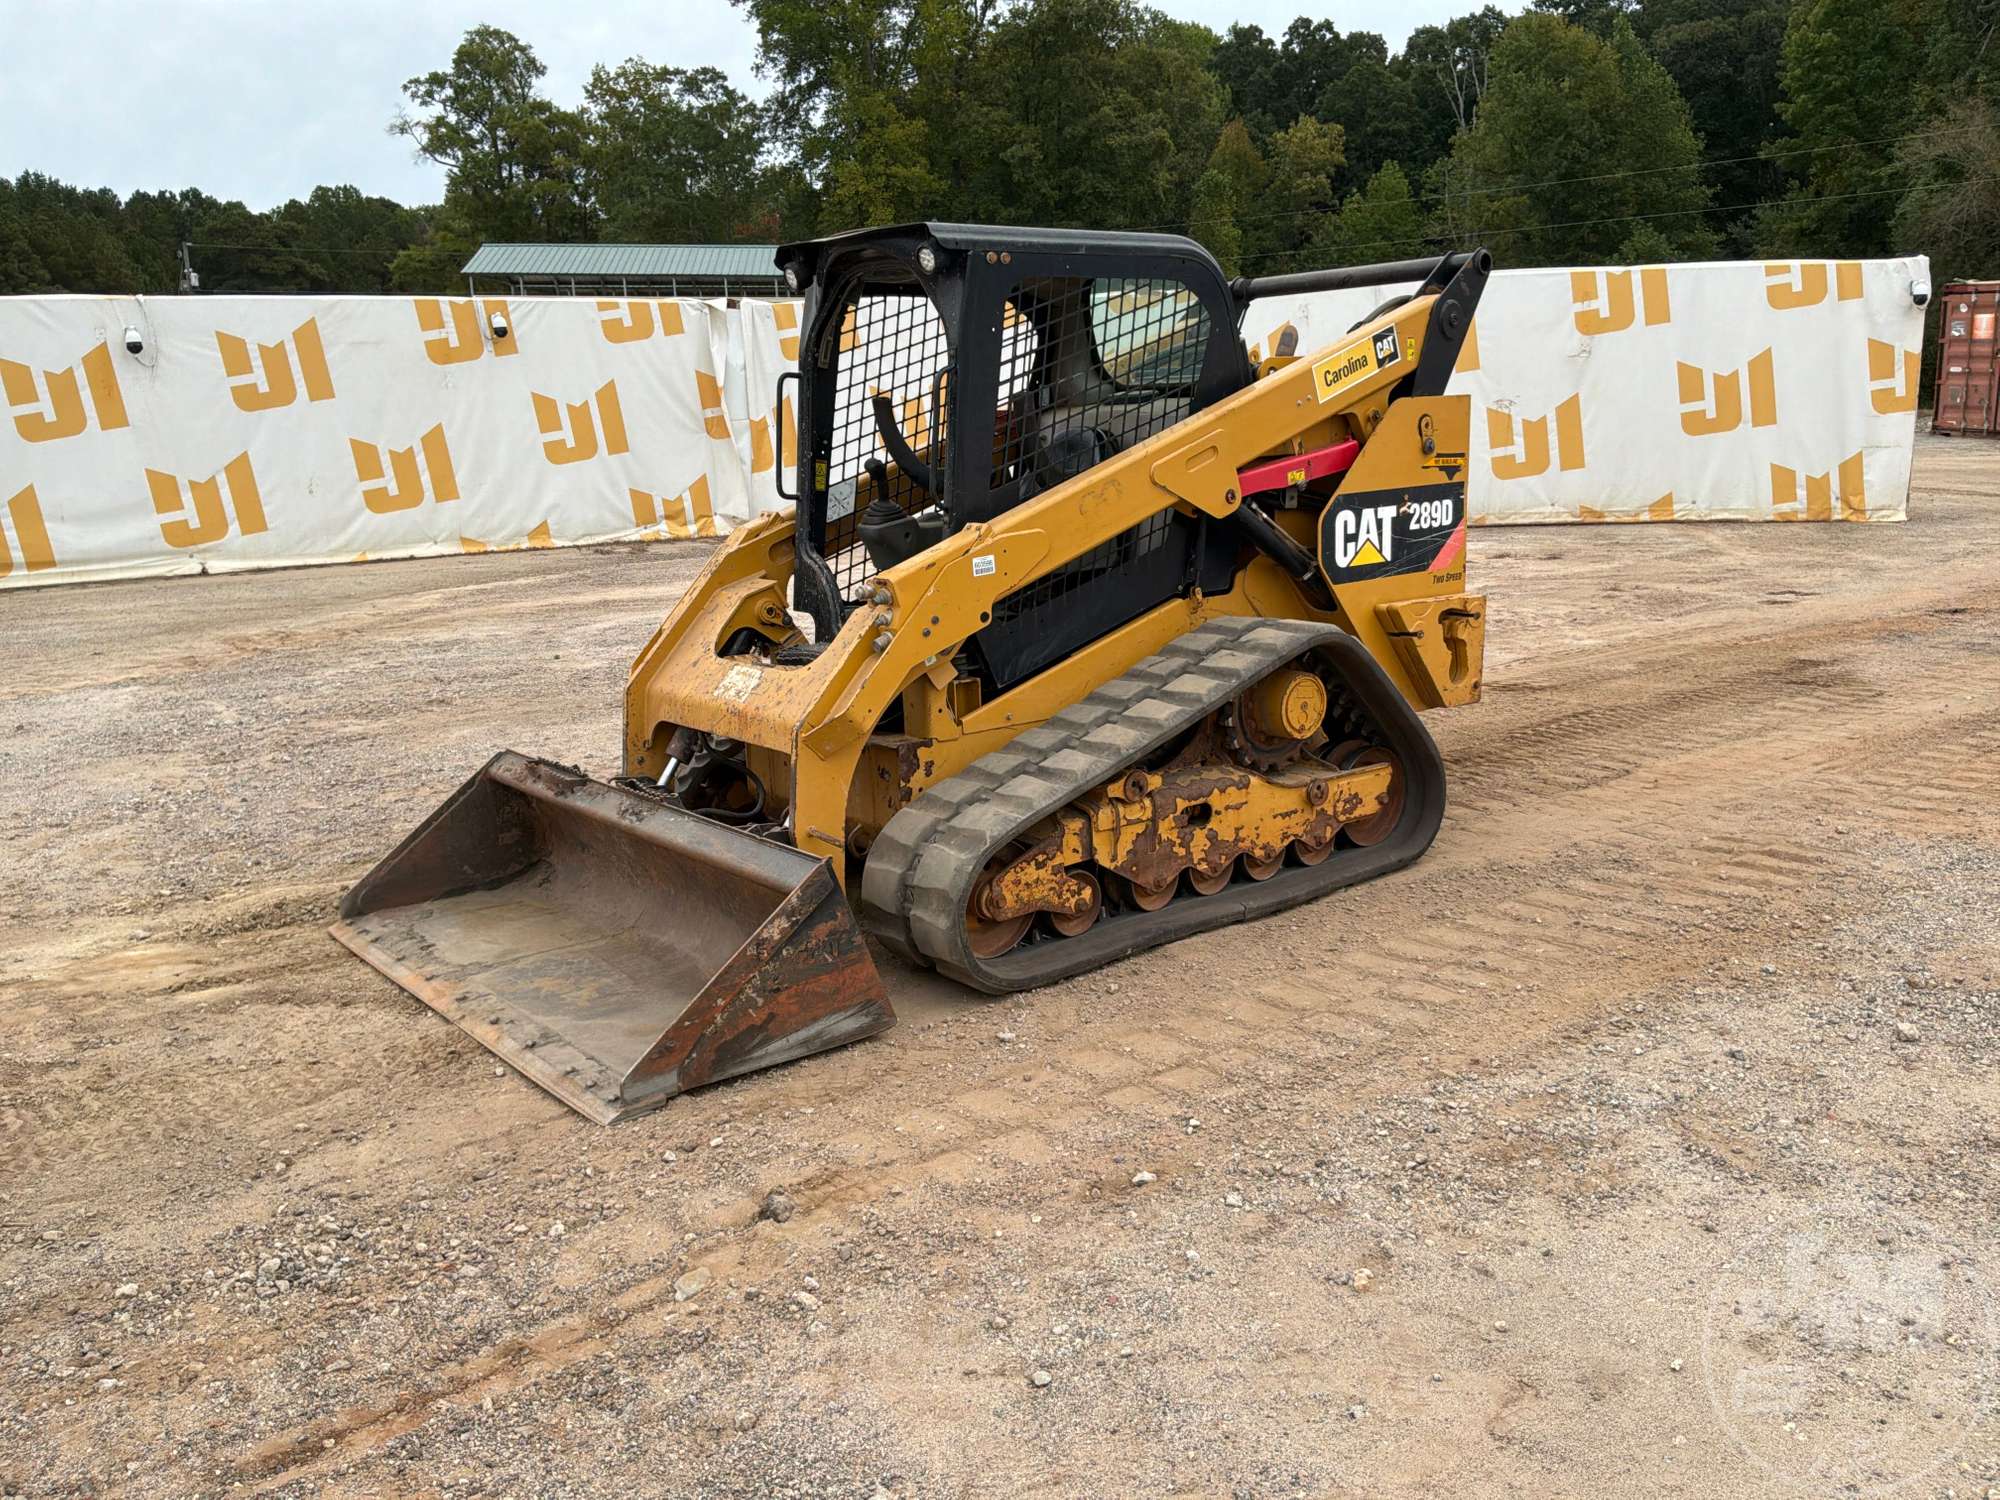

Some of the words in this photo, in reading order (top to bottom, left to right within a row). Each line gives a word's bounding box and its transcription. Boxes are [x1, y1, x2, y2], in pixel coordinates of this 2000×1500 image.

[1324, 355, 1368, 387] Carolina
[1376, 335, 1394, 359] CAT
[1335, 505, 1397, 568] CAT
[1409, 499, 1453, 530] 289D
